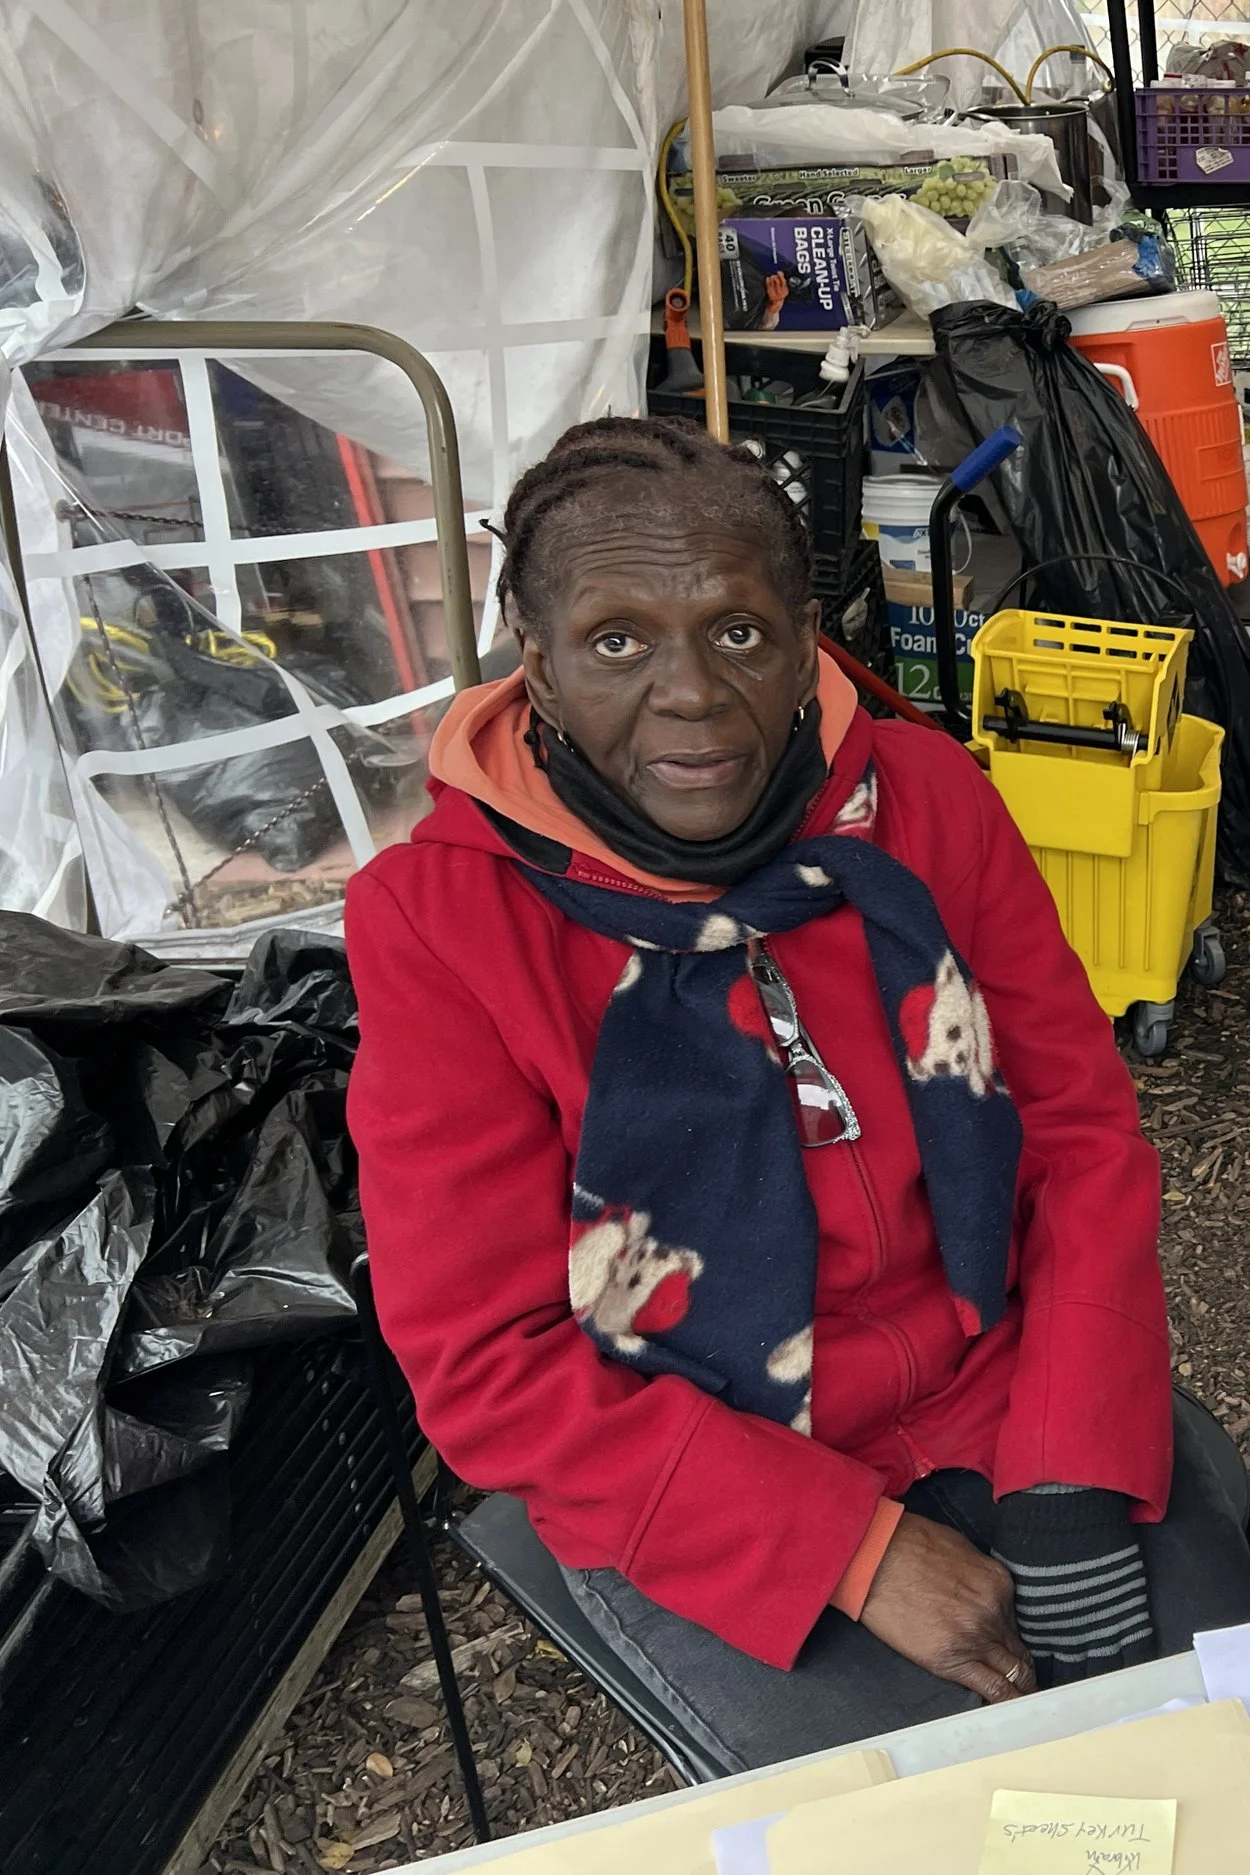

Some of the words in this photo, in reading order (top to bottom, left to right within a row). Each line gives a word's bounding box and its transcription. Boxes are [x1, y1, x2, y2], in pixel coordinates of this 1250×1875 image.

[722, 175, 757, 184] Sweeter
[799, 170, 821, 179] Hand
[822, 168, 860, 178] Selected
[904, 166, 932, 176] Larger
[724, 234, 736, 252] 40
[794, 226, 811, 274] BAGS
[810, 226, 834, 311] CLEAN-UP
